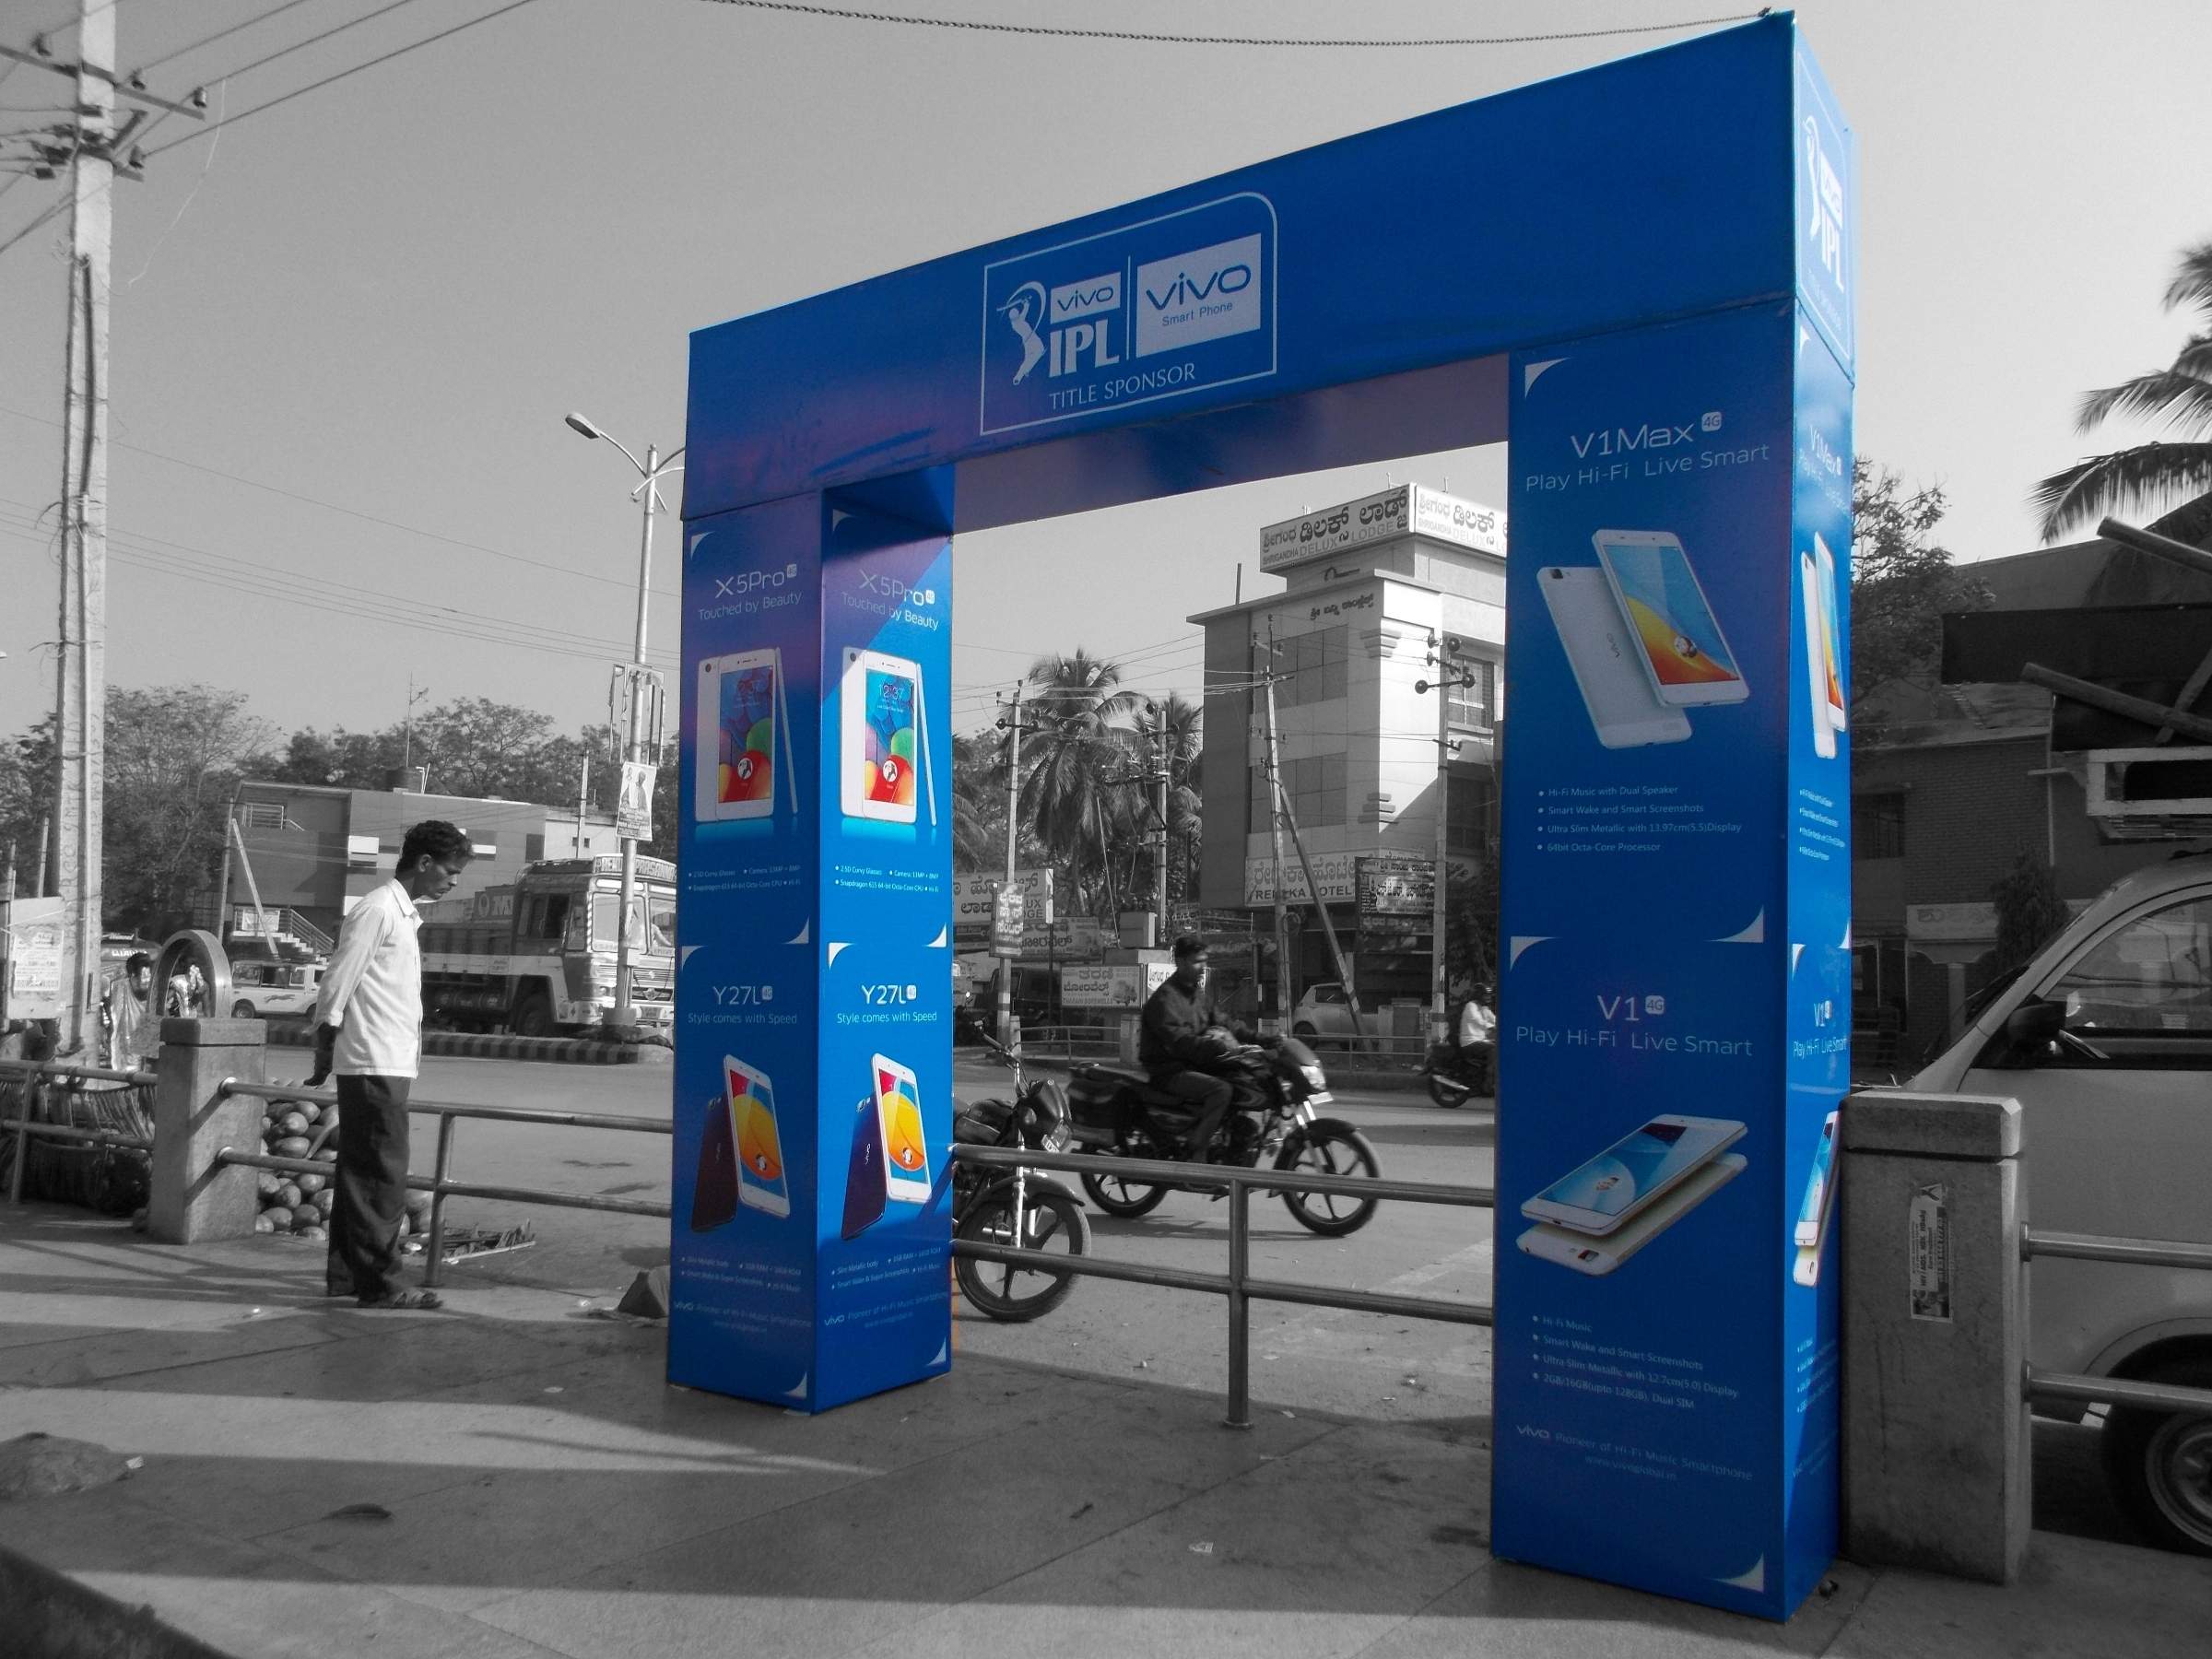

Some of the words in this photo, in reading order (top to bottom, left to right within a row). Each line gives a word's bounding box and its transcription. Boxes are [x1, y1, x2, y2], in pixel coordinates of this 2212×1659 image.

[1058, 287, 1114, 312] vivo
[1146, 265, 1252, 311] vivo
[1161, 310, 1194, 328] Smart
[1199, 302, 1233, 319] Phone
[1049, 318, 1120, 378] IPL
[1049, 384, 1098, 410] TITLE
[1104, 362, 1196, 400] SPONSOR
[1571, 423, 1695, 459] V1Max
[1526, 474, 1571, 492] Play
[1577, 463, 1630, 486] Hi-Fi
[1644, 456, 1693, 477] Live
[1700, 443, 1771, 470] Smart
[1300, 537, 1337, 557] DELUX
[1351, 522, 1394, 542] LODGE
[715, 571, 785, 599] X5Pro
[859, 569, 924, 606] X5Pro
[699, 604, 742, 620] Touched
[745, 599, 759, 613] by
[763, 590, 804, 609] Beauty
[841, 591, 886, 615] Touched
[888, 605, 902, 621] by
[905, 609, 939, 631] Beauty
[1548, 806, 1573, 816] Smart
[1575, 806, 1600, 815] Wake
[1601, 805, 1618, 815] and
[1620, 804, 1647, 814] Smart
[1649, 803, 1704, 814] Screenshots
[1255, 887, 1307, 900] REKA
[1310, 885, 1353, 899] OTEL
[712, 985, 761, 1006] Y27L
[861, 984, 906, 1005] Y27L
[1596, 995, 1640, 1021] V1
[1646, 997, 1665, 1012] 4G
[688, 1012, 712, 1026] Style
[712, 1014, 742, 1025] comes
[745, 1012, 766, 1024] with
[767, 1012, 797, 1026] Speed
[836, 1012, 860, 1025] Style
[861, 1013, 889, 1024] comes
[892, 1011, 912, 1022] with
[912, 1010, 937, 1023] Speed
[1516, 1026, 1559, 1048] Play
[1567, 1030, 1617, 1047] Hi-Fi
[1630, 1031, 1678, 1052] Live
[1684, 1035, 1754, 1056] Smart
[1543, 1335, 1570, 1348] Smart
[1571, 1340, 1596, 1354] Wake
[1597, 1345, 1616, 1357] and
[1618, 1347, 1645, 1362] Smart
[1646, 1352, 1704, 1371] Screenshots
[1516, 1424, 1550, 1440] vivo
[1555, 1432, 1597, 1450] Pioneer
[1599, 1441, 1613, 1453] of
[1645, 1449, 1679, 1466] Music
[1681, 1456, 1754, 1481] Smartphone
